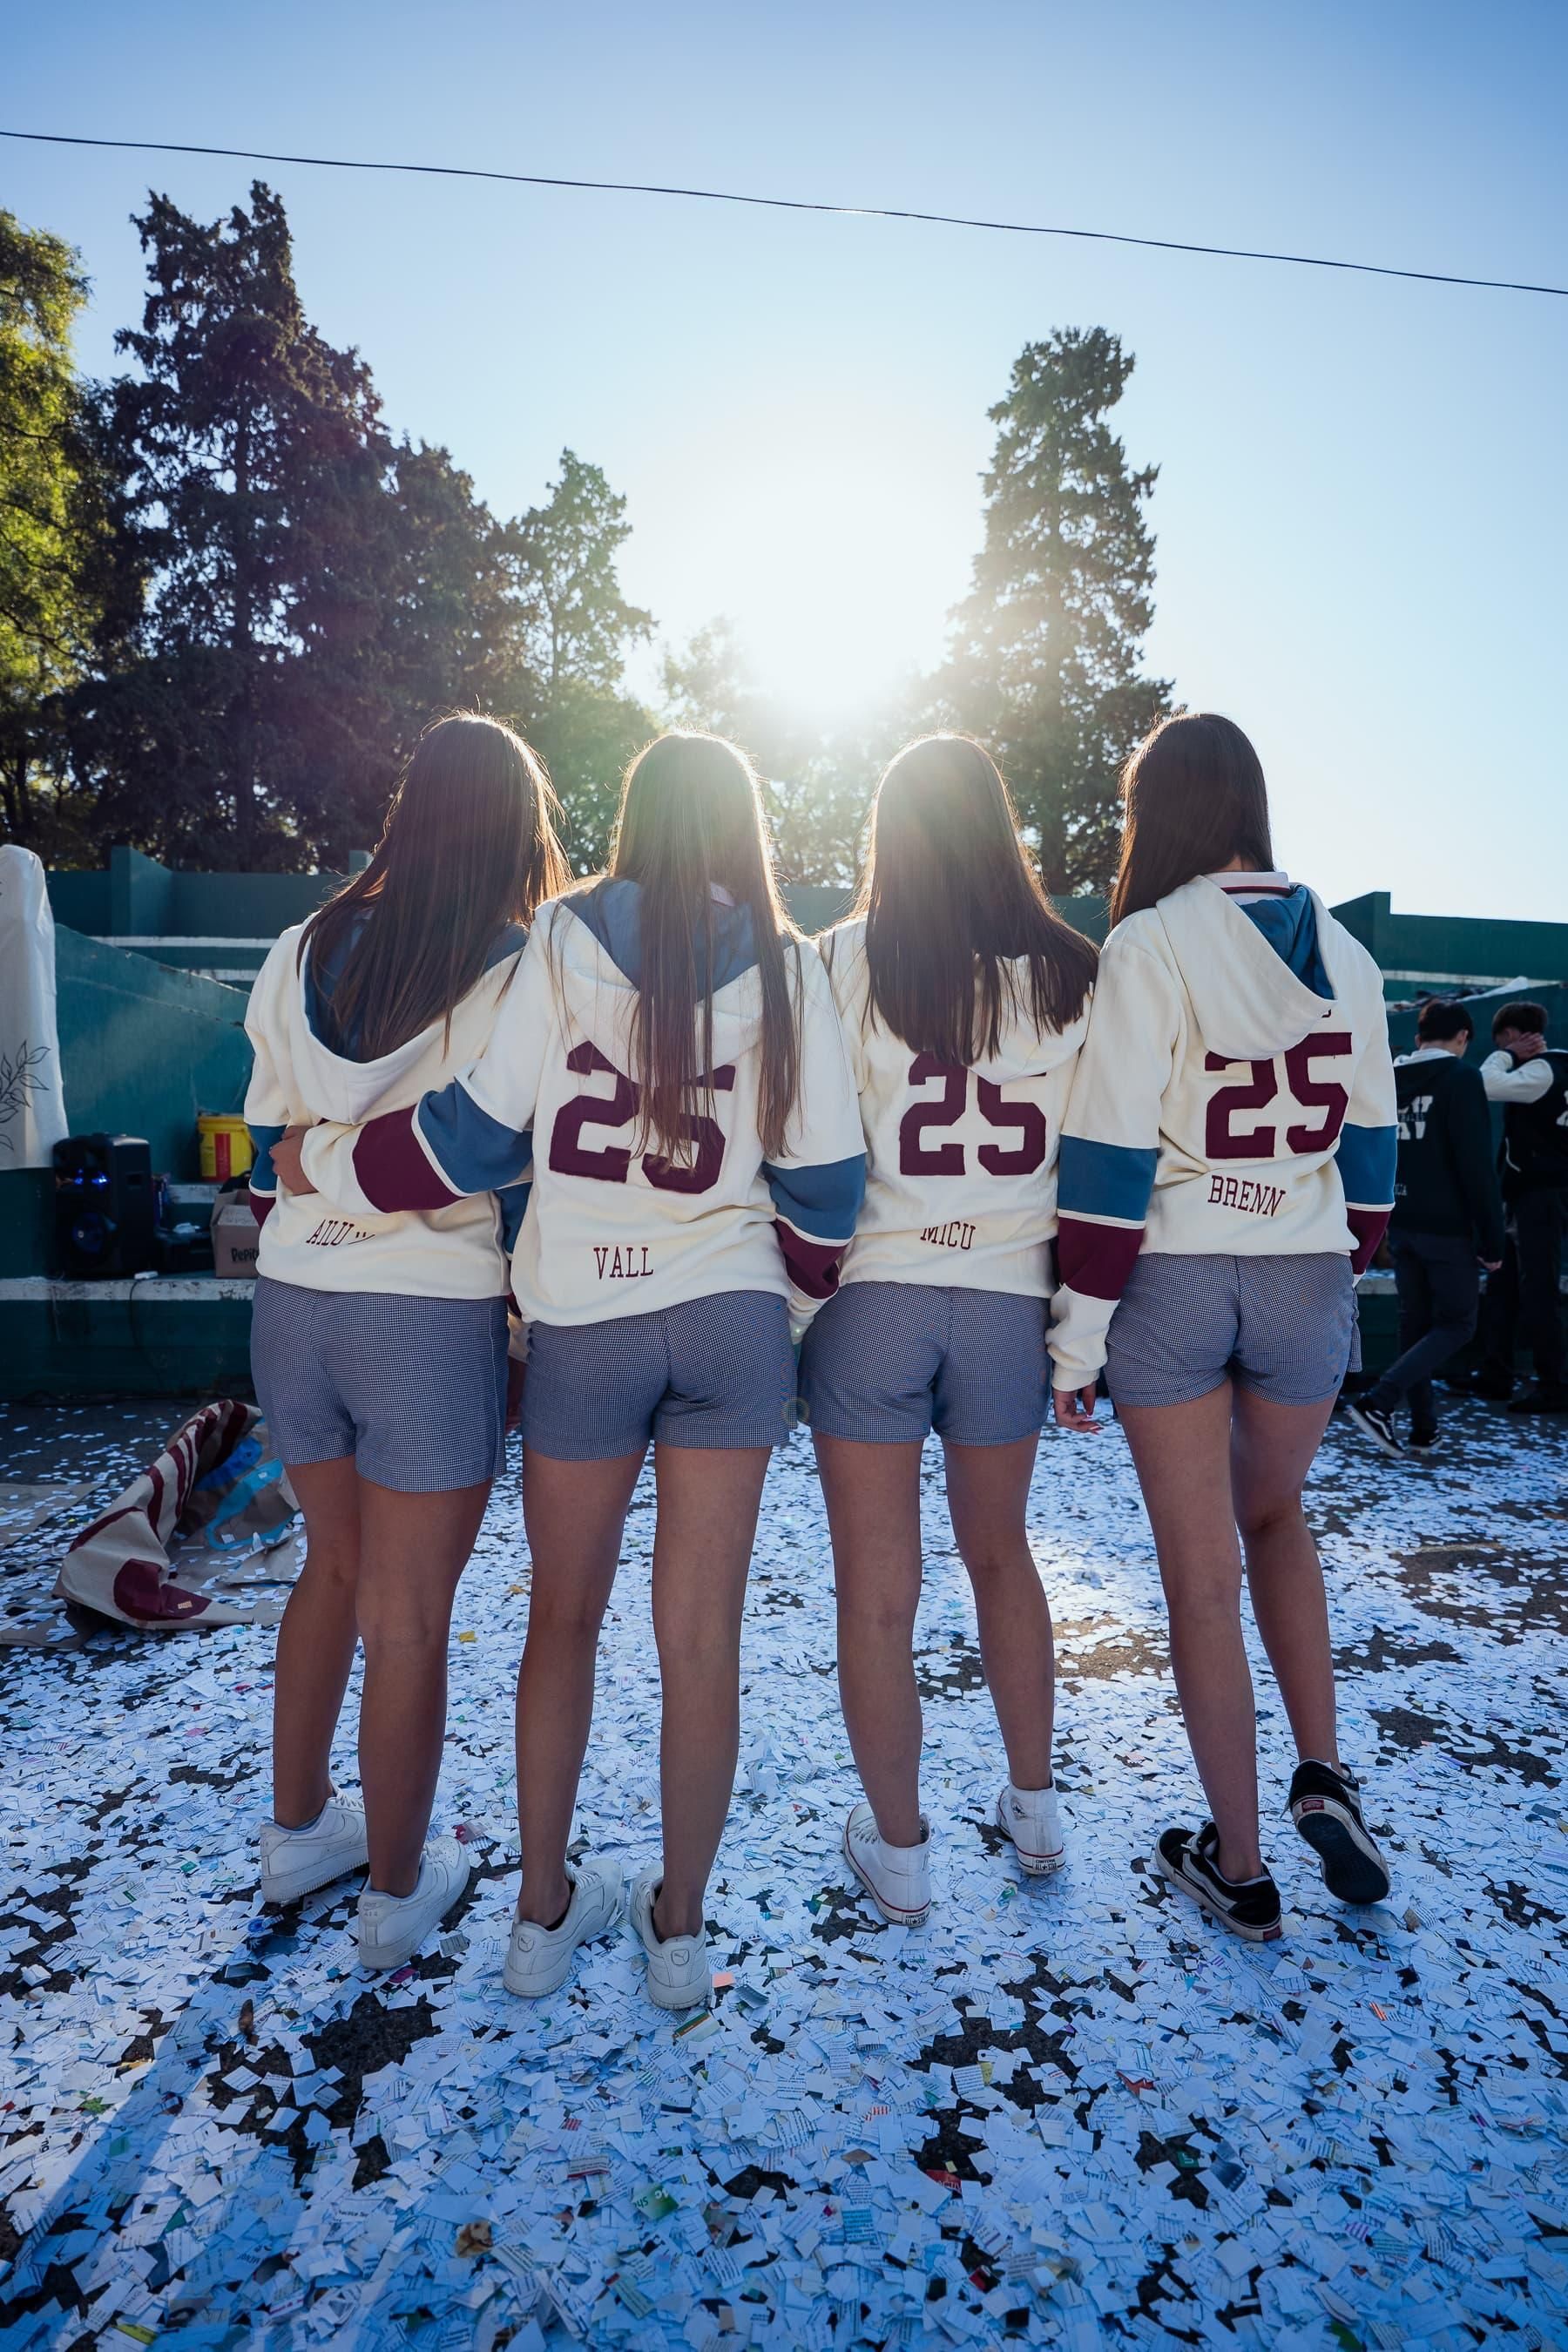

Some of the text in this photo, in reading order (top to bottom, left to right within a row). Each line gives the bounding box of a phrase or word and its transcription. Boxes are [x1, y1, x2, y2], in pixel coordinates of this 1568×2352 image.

[548, 1039, 736, 1195] 25
[899, 1051, 1047, 1177] 25
[1205, 1031, 1353, 1160] 25
[920, 1220, 977, 1251] MICU
[1206, 1174, 1288, 1219] BRENN
[593, 1247, 654, 1281] VALL
